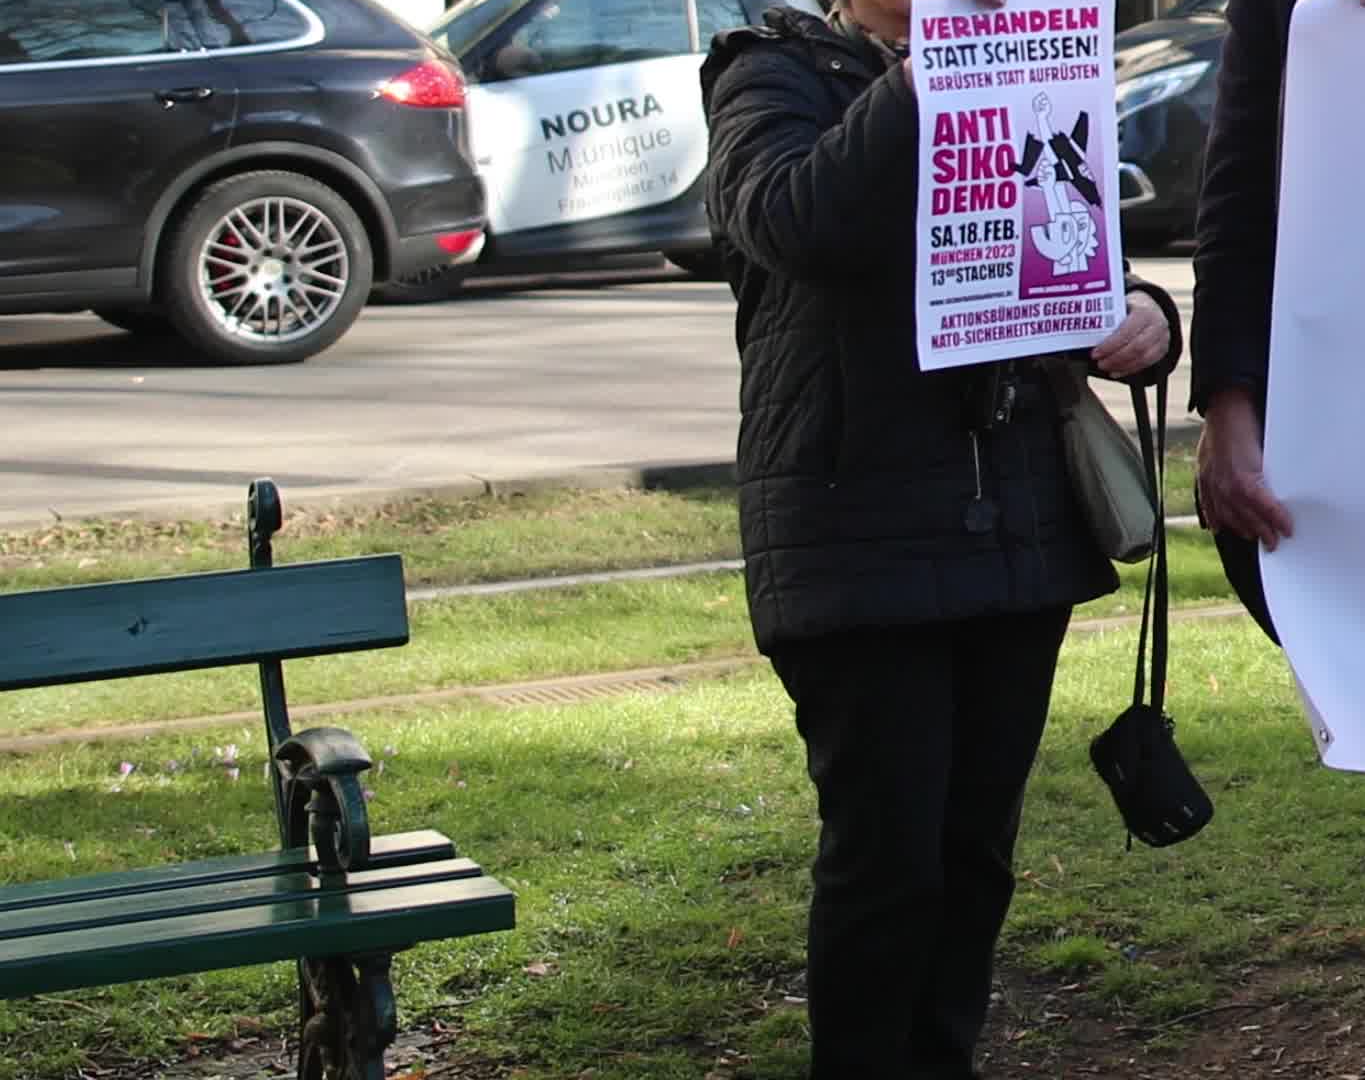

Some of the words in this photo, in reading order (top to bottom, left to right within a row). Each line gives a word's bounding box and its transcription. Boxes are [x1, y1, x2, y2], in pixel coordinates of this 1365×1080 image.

[920, 6, 1099, 41] VERHANDELN
[922, 43, 978, 70] STATT
[983, 34, 1099, 66] SCHIESSEN!
[928, 70, 994, 93] ABRÜSTEN
[996, 69, 1026, 87] STATT
[1028, 63, 1100, 83] AUFRÜSTEN
[539, 92, 664, 141] NOURA
[931, 106, 1011, 147] ANTI
[931, 143, 1016, 185] SIKO
[930, 180, 1018, 216] DEMO
[930, 245, 983, 266] MÜNCHEN
[984, 243, 1016, 260] 2023
[940, 302, 1042, 331] AKTIONSBÜNDNIS
[1042, 298, 1083, 317] GEGEN
[1084, 296, 1103, 314] DIE
[930, 314, 1104, 350] NATO-SICHERHEITSKONFERENZ
